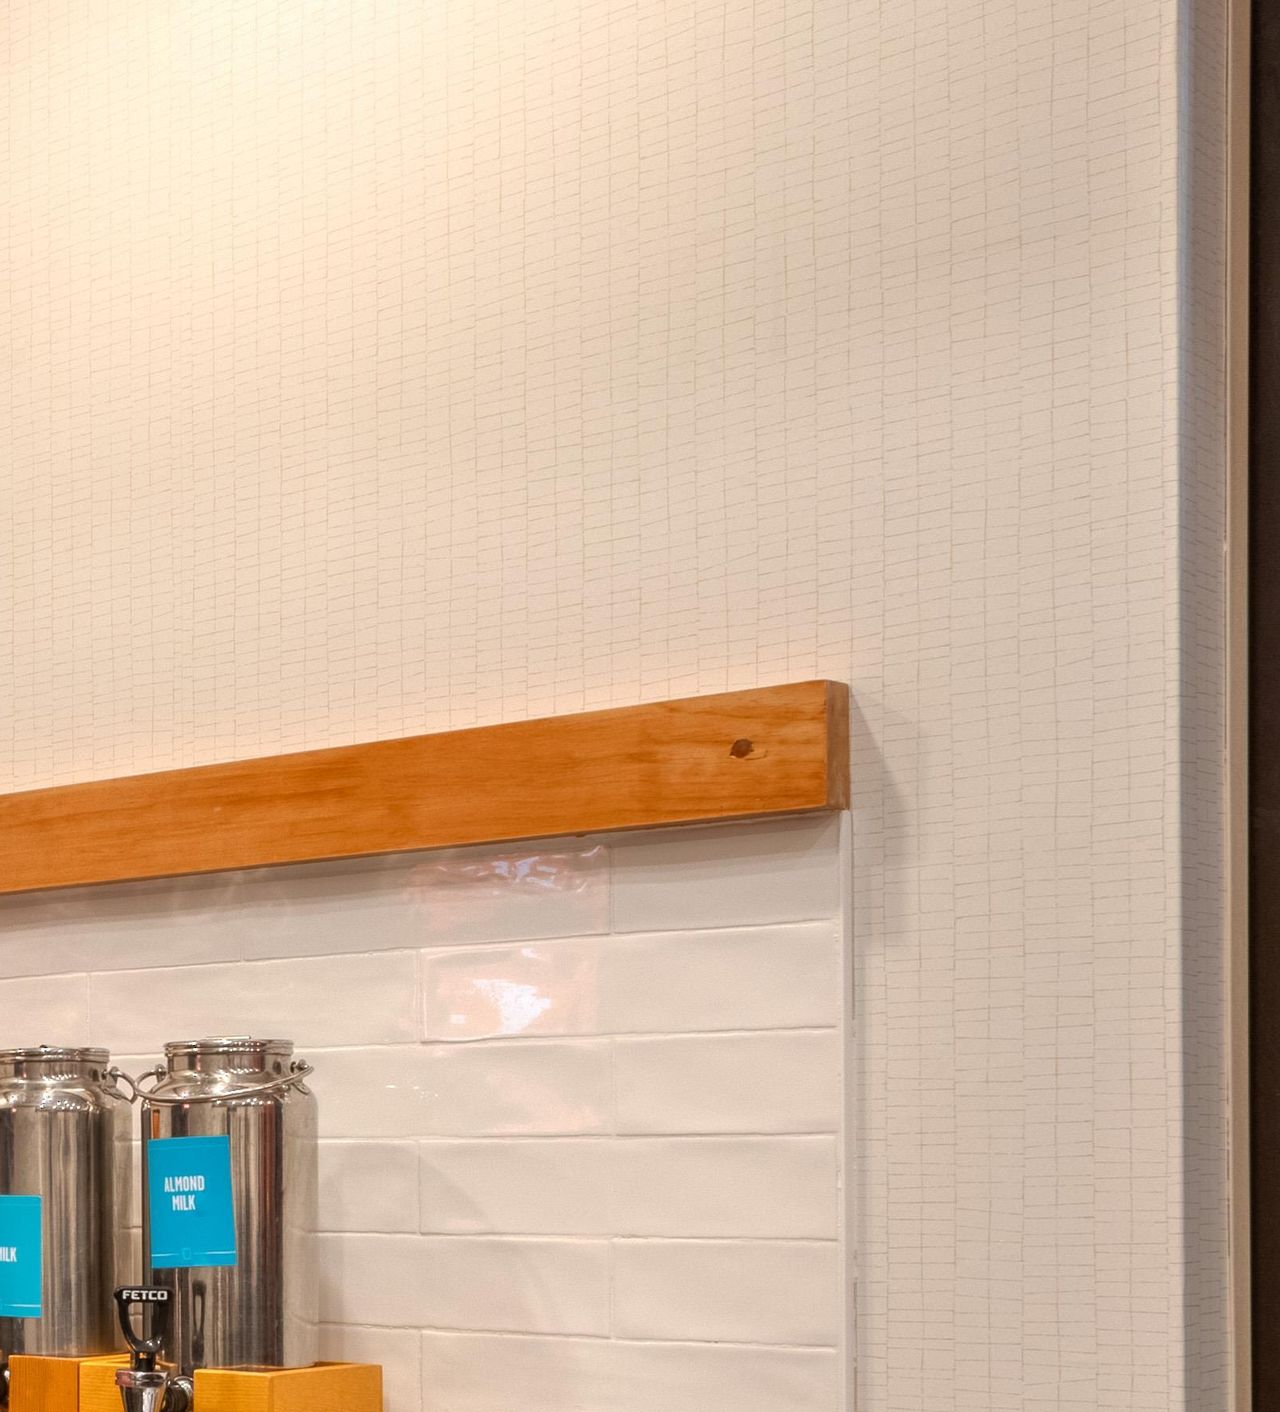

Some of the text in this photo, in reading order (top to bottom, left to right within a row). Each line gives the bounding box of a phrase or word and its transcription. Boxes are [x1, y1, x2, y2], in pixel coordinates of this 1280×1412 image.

[163, 1175, 205, 1193] ALMOND
[172, 1195, 196, 1212] MILK
[122, 1289, 168, 1301] FETCO
